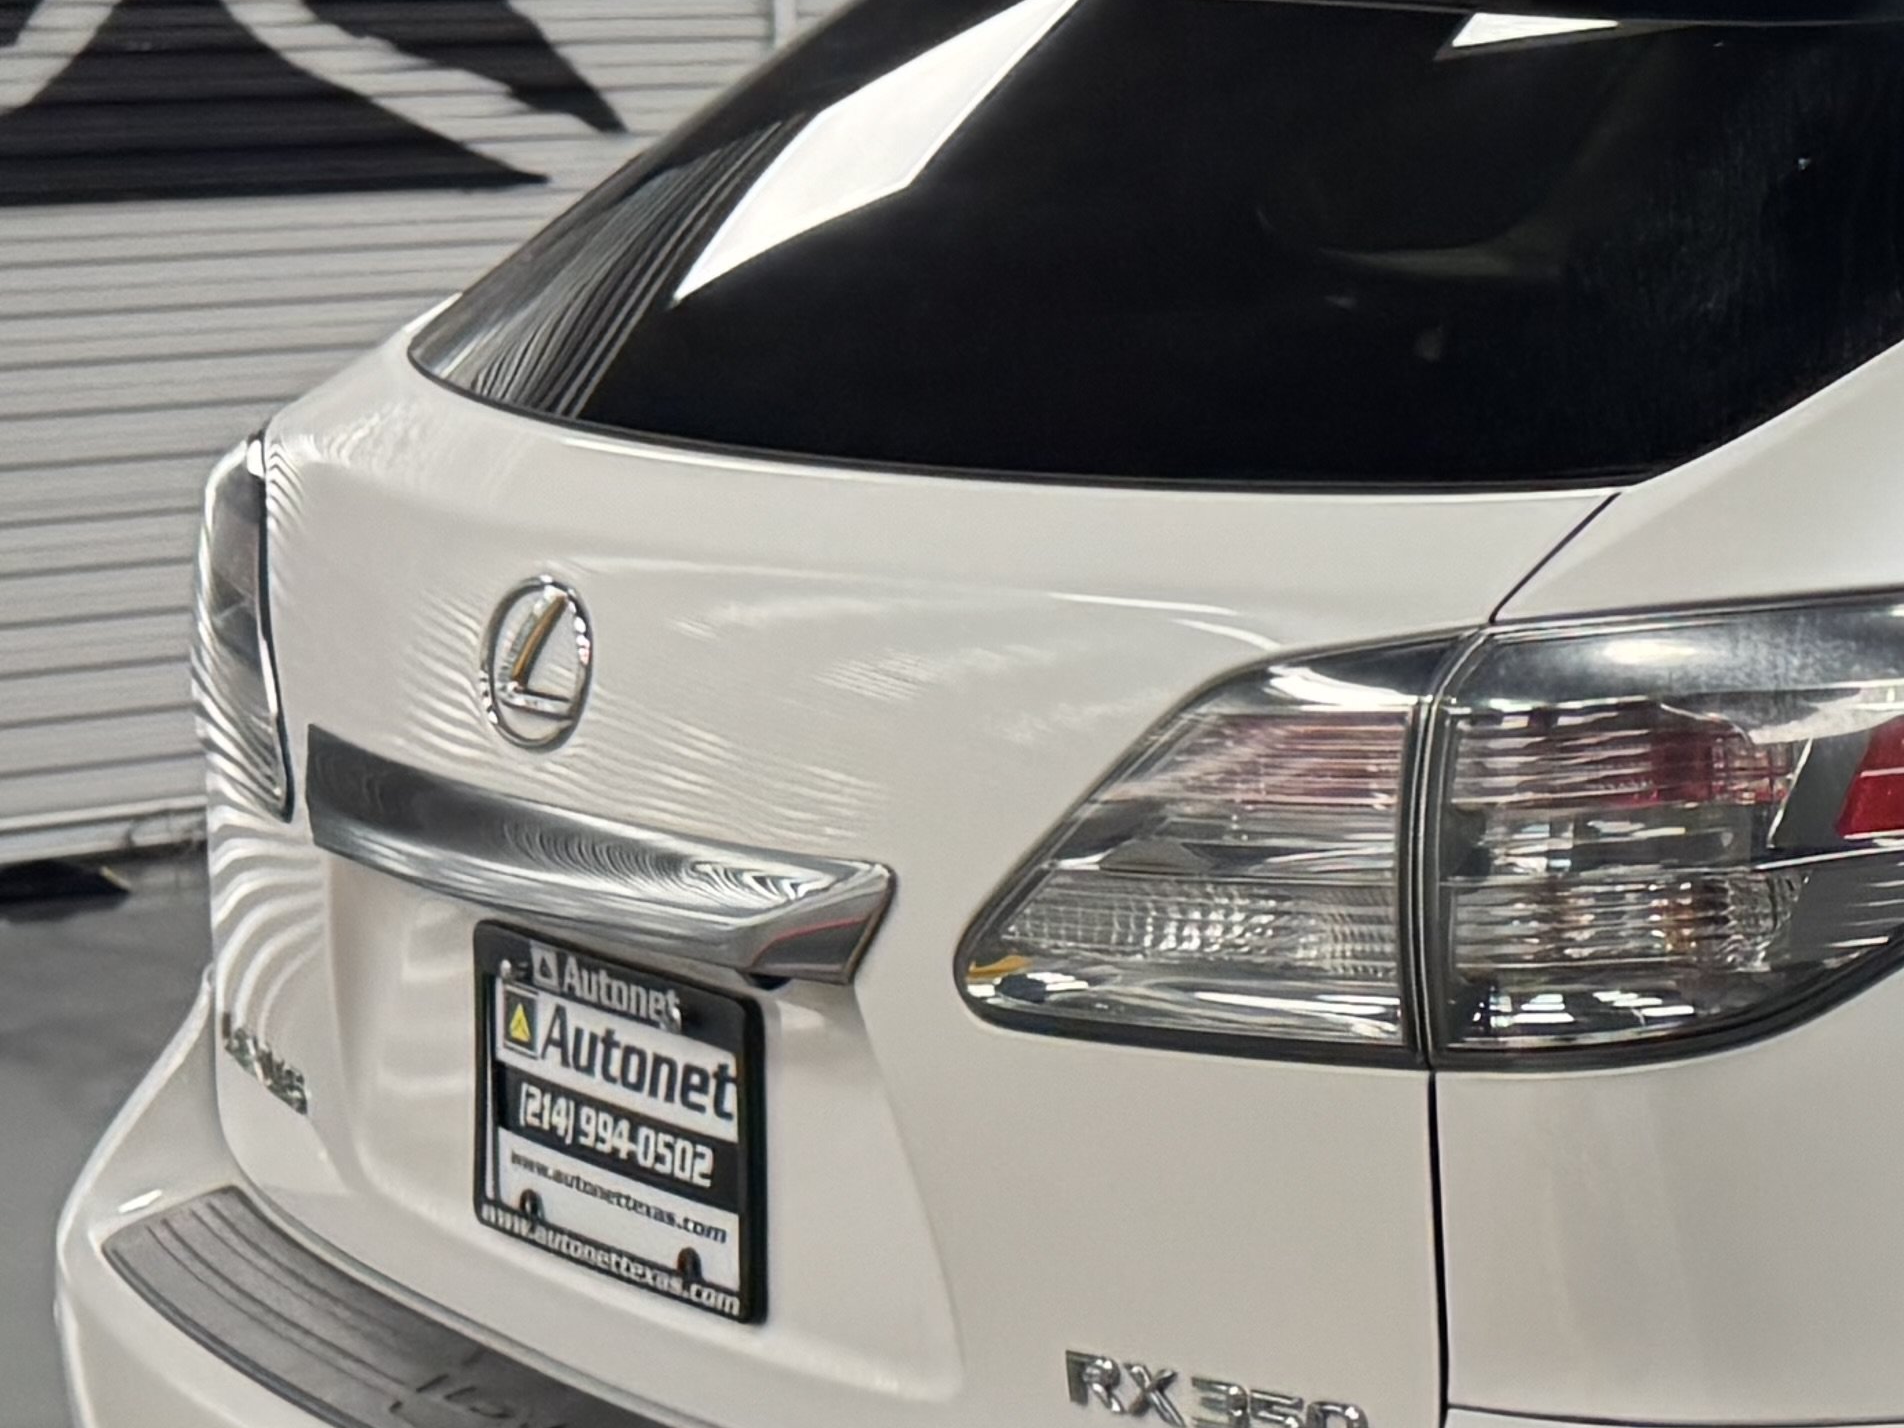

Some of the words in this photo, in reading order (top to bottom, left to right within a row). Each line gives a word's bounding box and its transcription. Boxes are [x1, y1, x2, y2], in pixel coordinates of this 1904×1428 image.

[562, 955, 681, 1030] Autonet
[540, 1004, 737, 1121] Autonet
[519, 1082, 574, 1146] (214)
[579, 1103, 715, 1188] 994-0502
[509, 1148, 728, 1244] www.autonettexas.com
